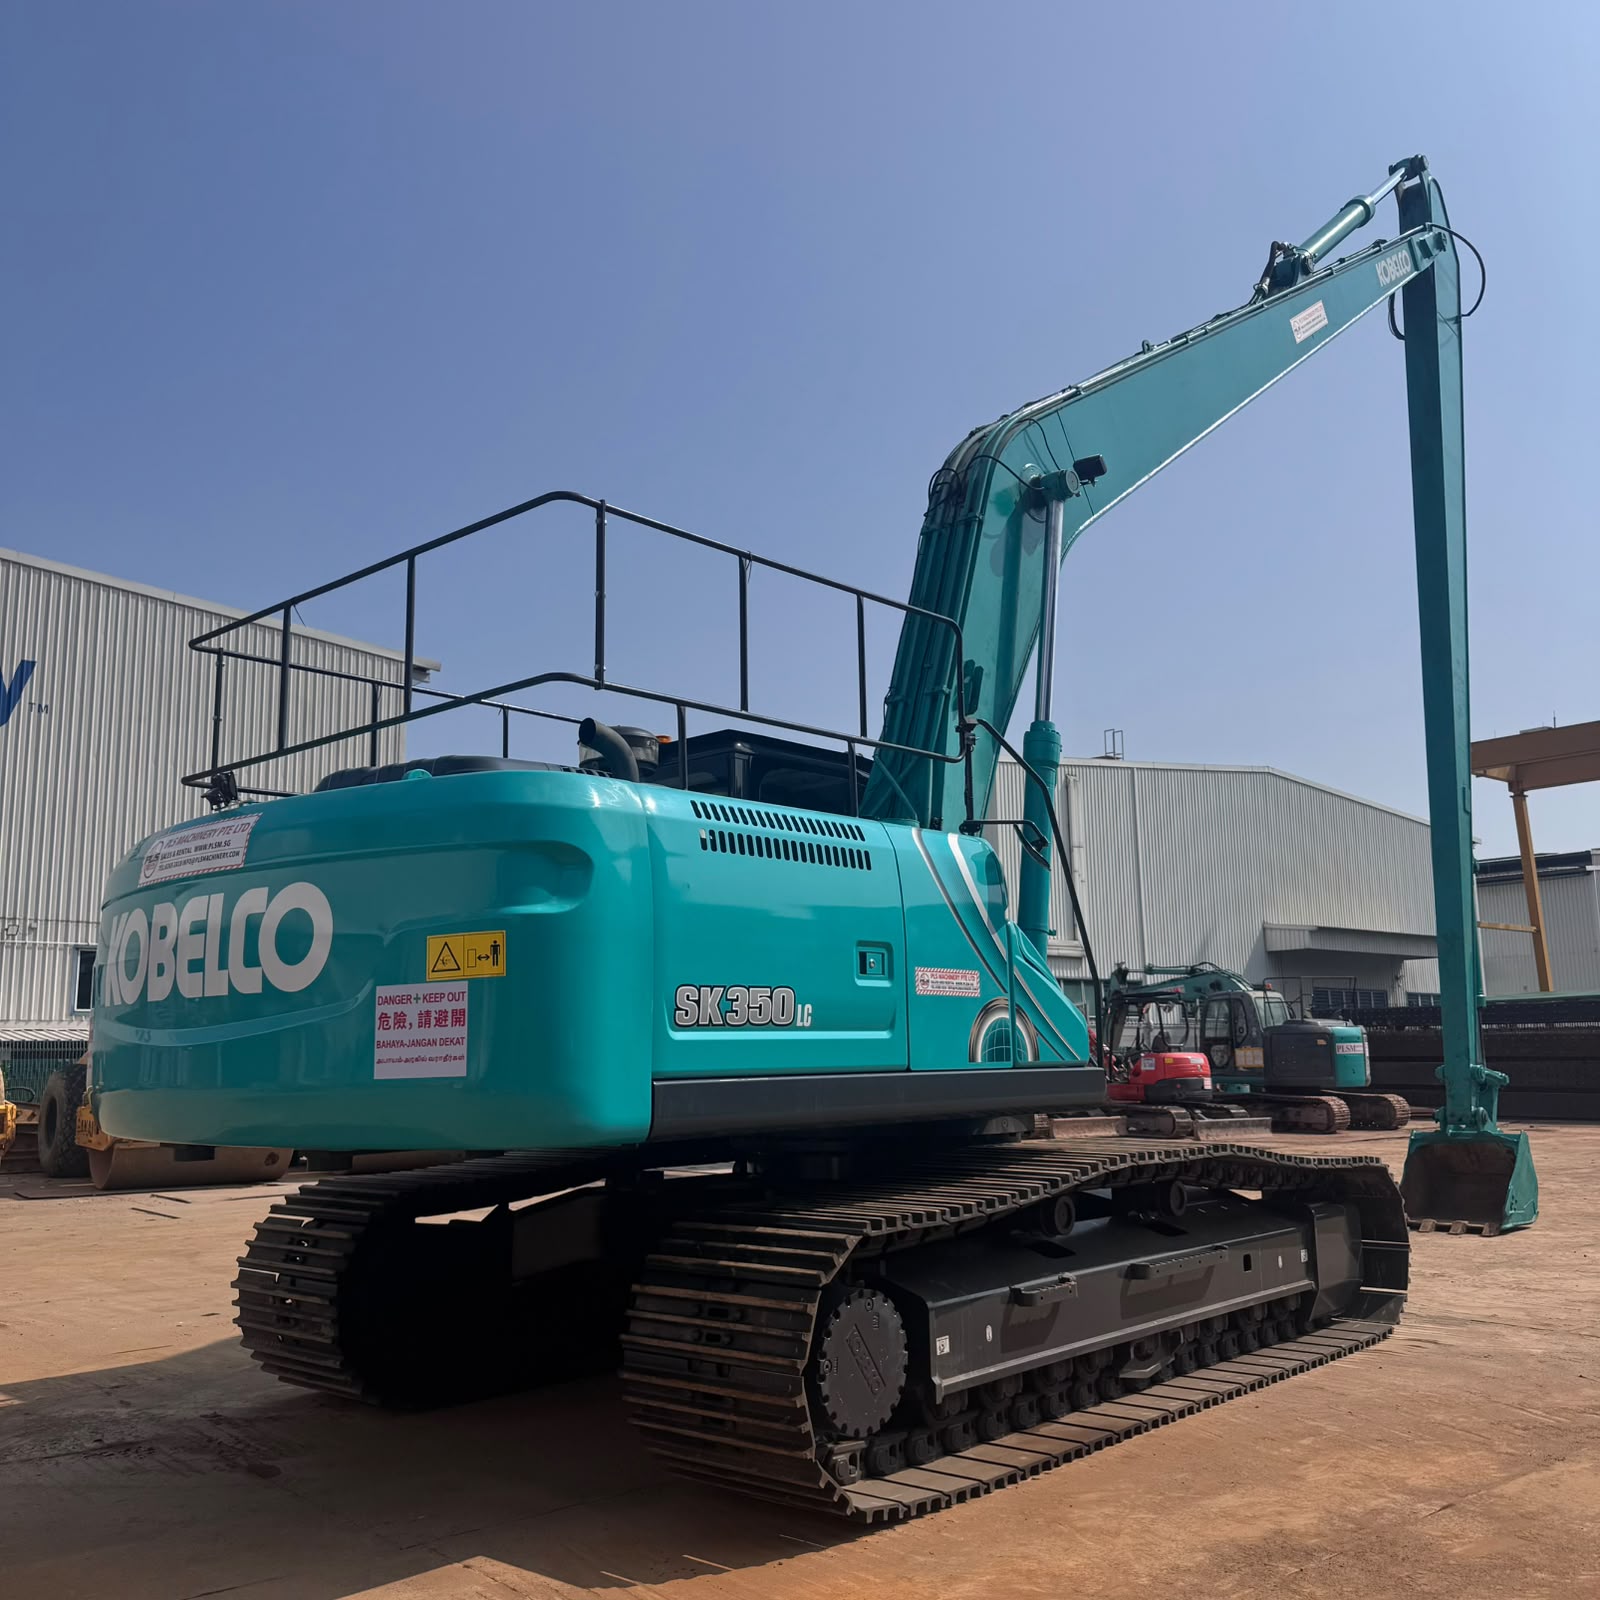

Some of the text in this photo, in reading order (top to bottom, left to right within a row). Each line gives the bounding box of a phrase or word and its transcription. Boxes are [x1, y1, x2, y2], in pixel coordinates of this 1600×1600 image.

[1376, 250, 1411, 286] KOBELCO
[218, 825, 234, 837] PTE
[233, 823, 250, 833] LTD
[194, 840, 231, 852] WWW.PLSM.SG
[105, 881, 333, 1007] KOBELCO
[377, 991, 466, 1006] DANGER KEEP OUT
[795, 1003, 812, 1027] LC
[376, 1036, 466, 1050] BAHAYA-JANGAN DEKAT
